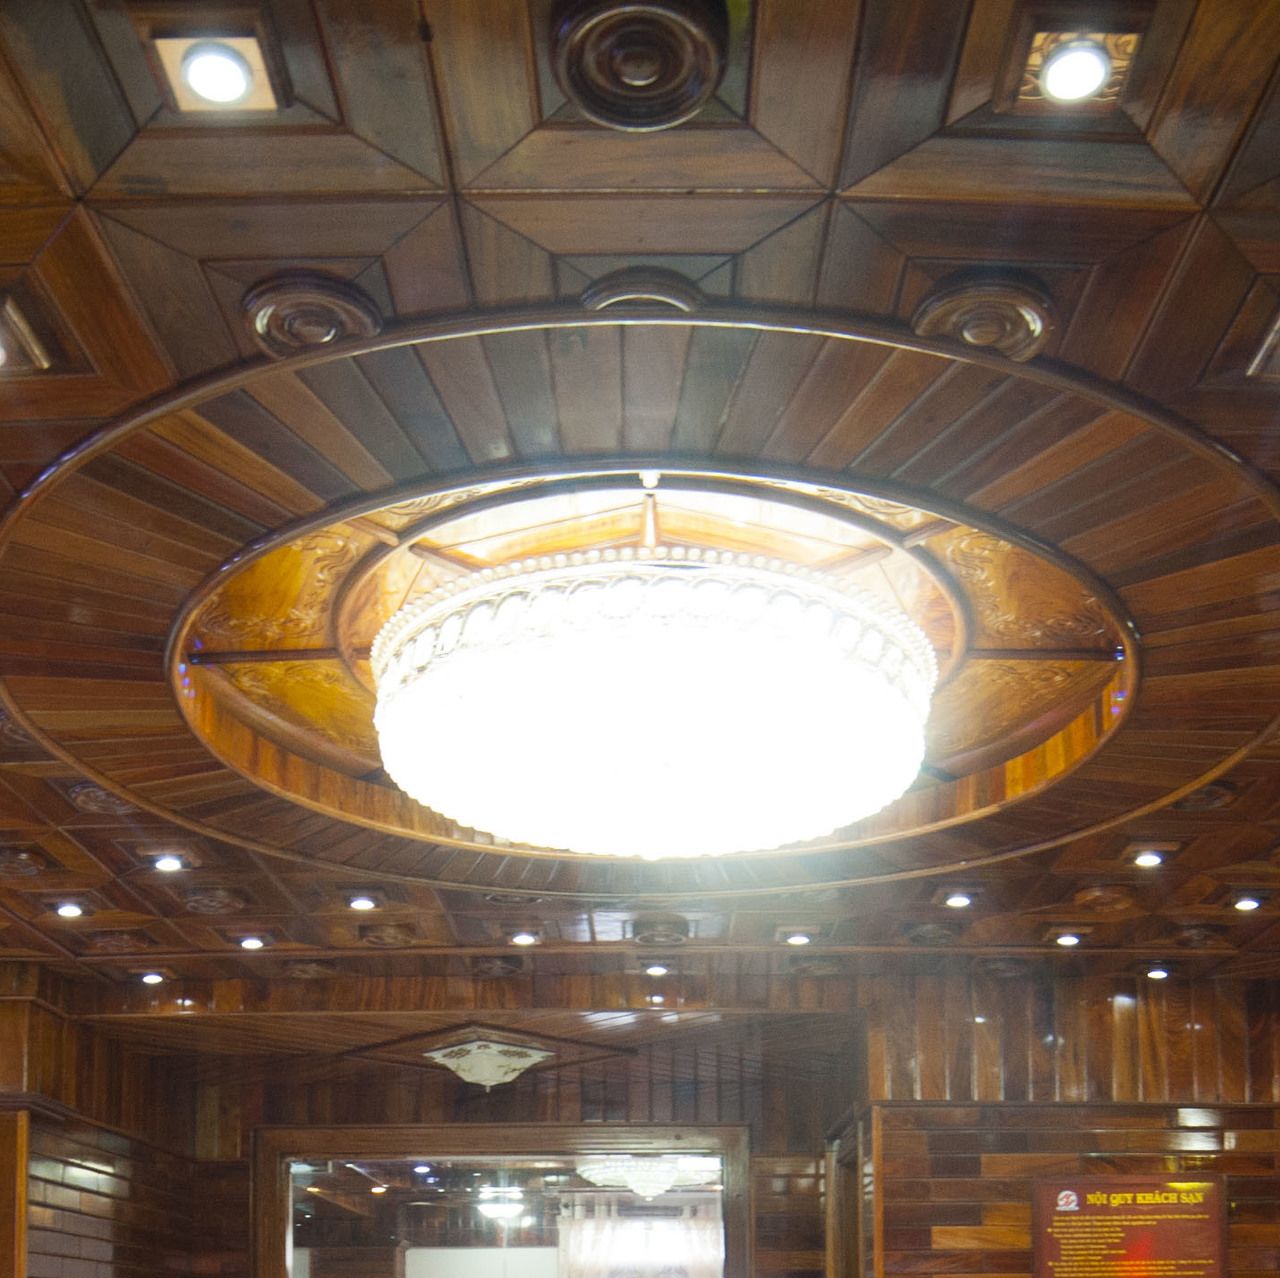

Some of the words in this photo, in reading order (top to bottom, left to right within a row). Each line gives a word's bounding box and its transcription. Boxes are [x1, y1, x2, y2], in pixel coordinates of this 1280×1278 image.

[1086, 1191, 1108, 1206] NỘI
[1109, 1192, 1134, 1207] QUY
[1136, 1190, 1179, 1204] KHÁCH
[1180, 1192, 1204, 1205] SẠN
